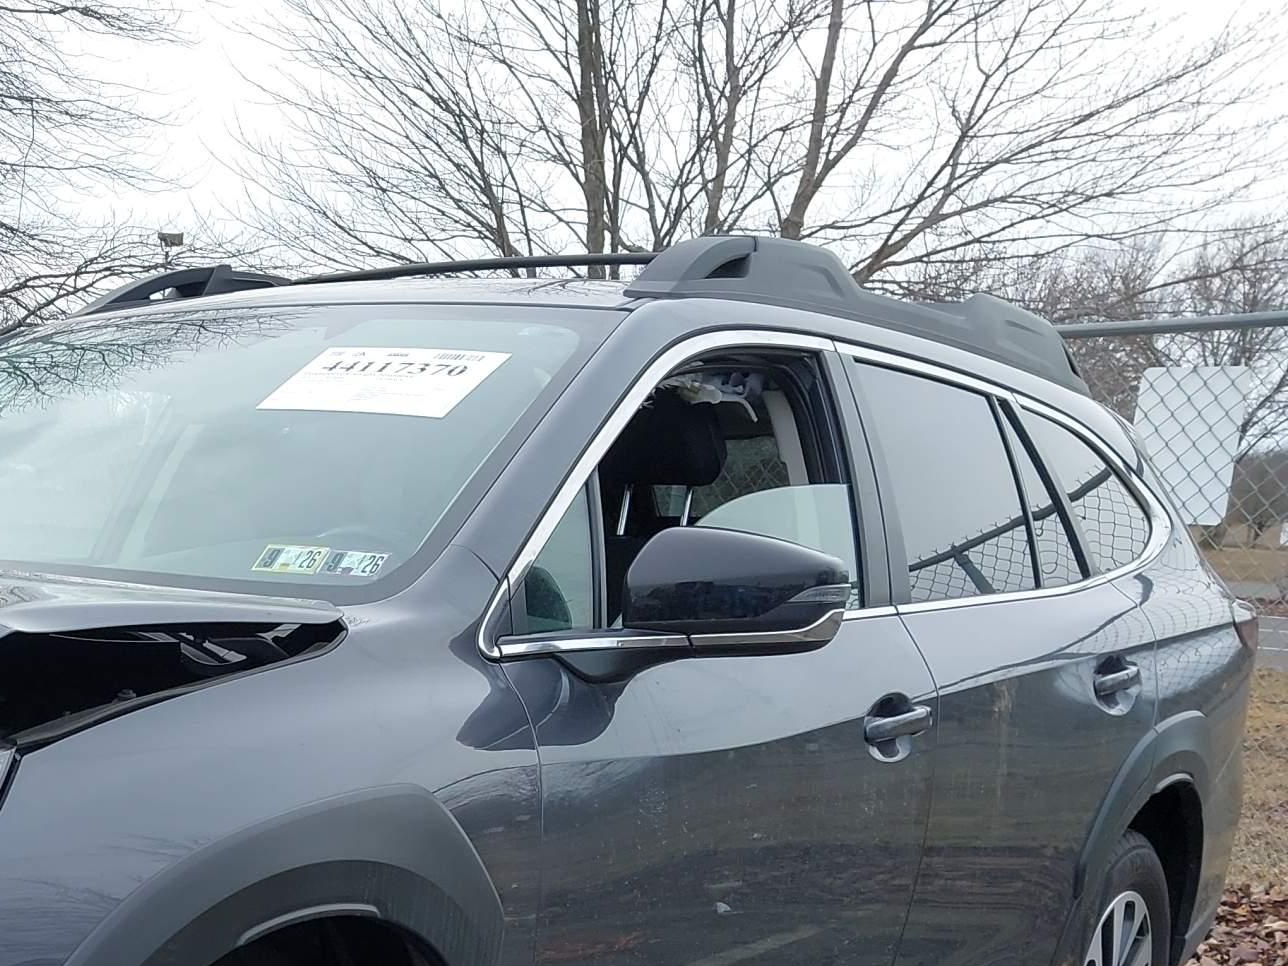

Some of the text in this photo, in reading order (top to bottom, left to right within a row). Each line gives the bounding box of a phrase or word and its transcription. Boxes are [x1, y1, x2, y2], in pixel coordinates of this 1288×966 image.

[321, 360, 469, 377] 44117370
[262, 549, 322, 569] 9 26
[361, 554, 385, 574] 26
